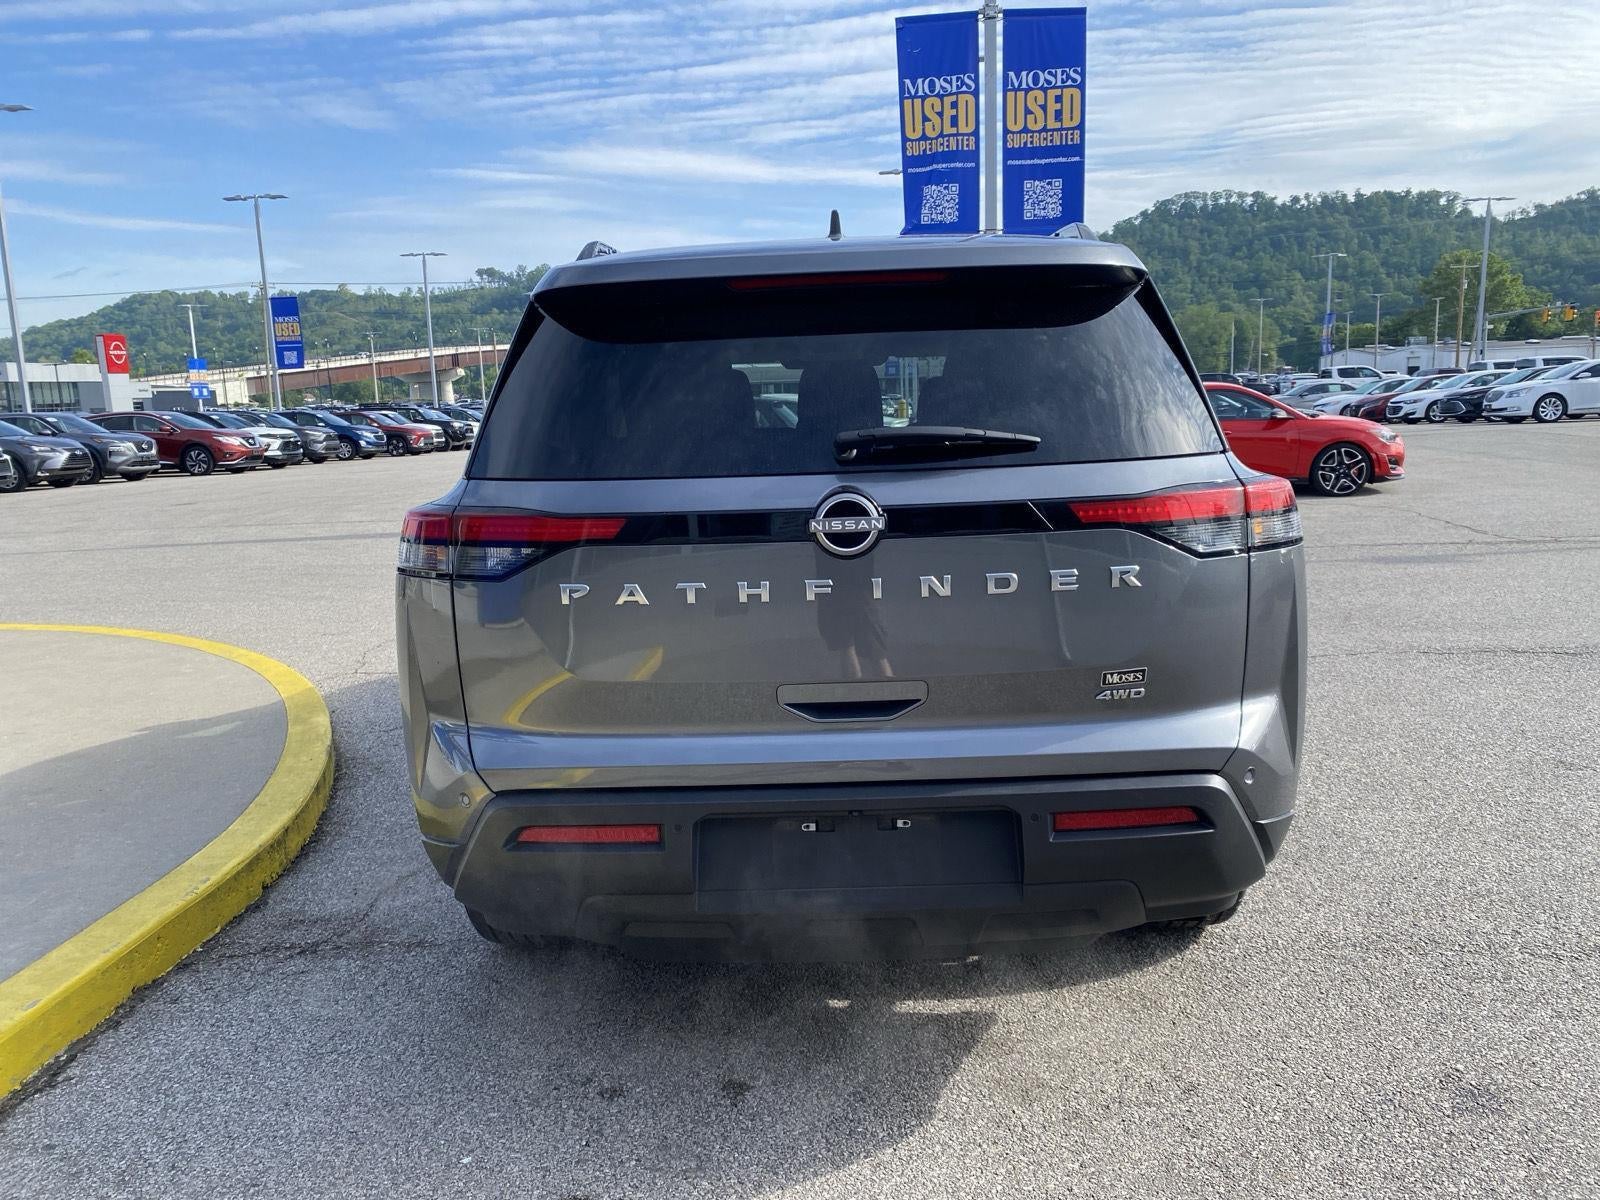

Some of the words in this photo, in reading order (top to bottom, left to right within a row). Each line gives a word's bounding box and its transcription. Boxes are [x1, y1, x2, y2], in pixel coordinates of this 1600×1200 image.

[903, 73, 976, 97] MOSES
[1007, 67, 1082, 89] MOSES
[903, 94, 976, 139] USED
[1006, 87, 1082, 132] USED
[906, 136, 976, 157] SUPERCENTER
[1007, 130, 1081, 148] SUPERCENTER
[275, 322, 300, 336] USED
[811, 519, 883, 531] NISSAN
[559, 564, 1143, 605] PATHFINDER
[1105, 672, 1143, 684] MOSES
[1095, 687, 1146, 701] 4WD
